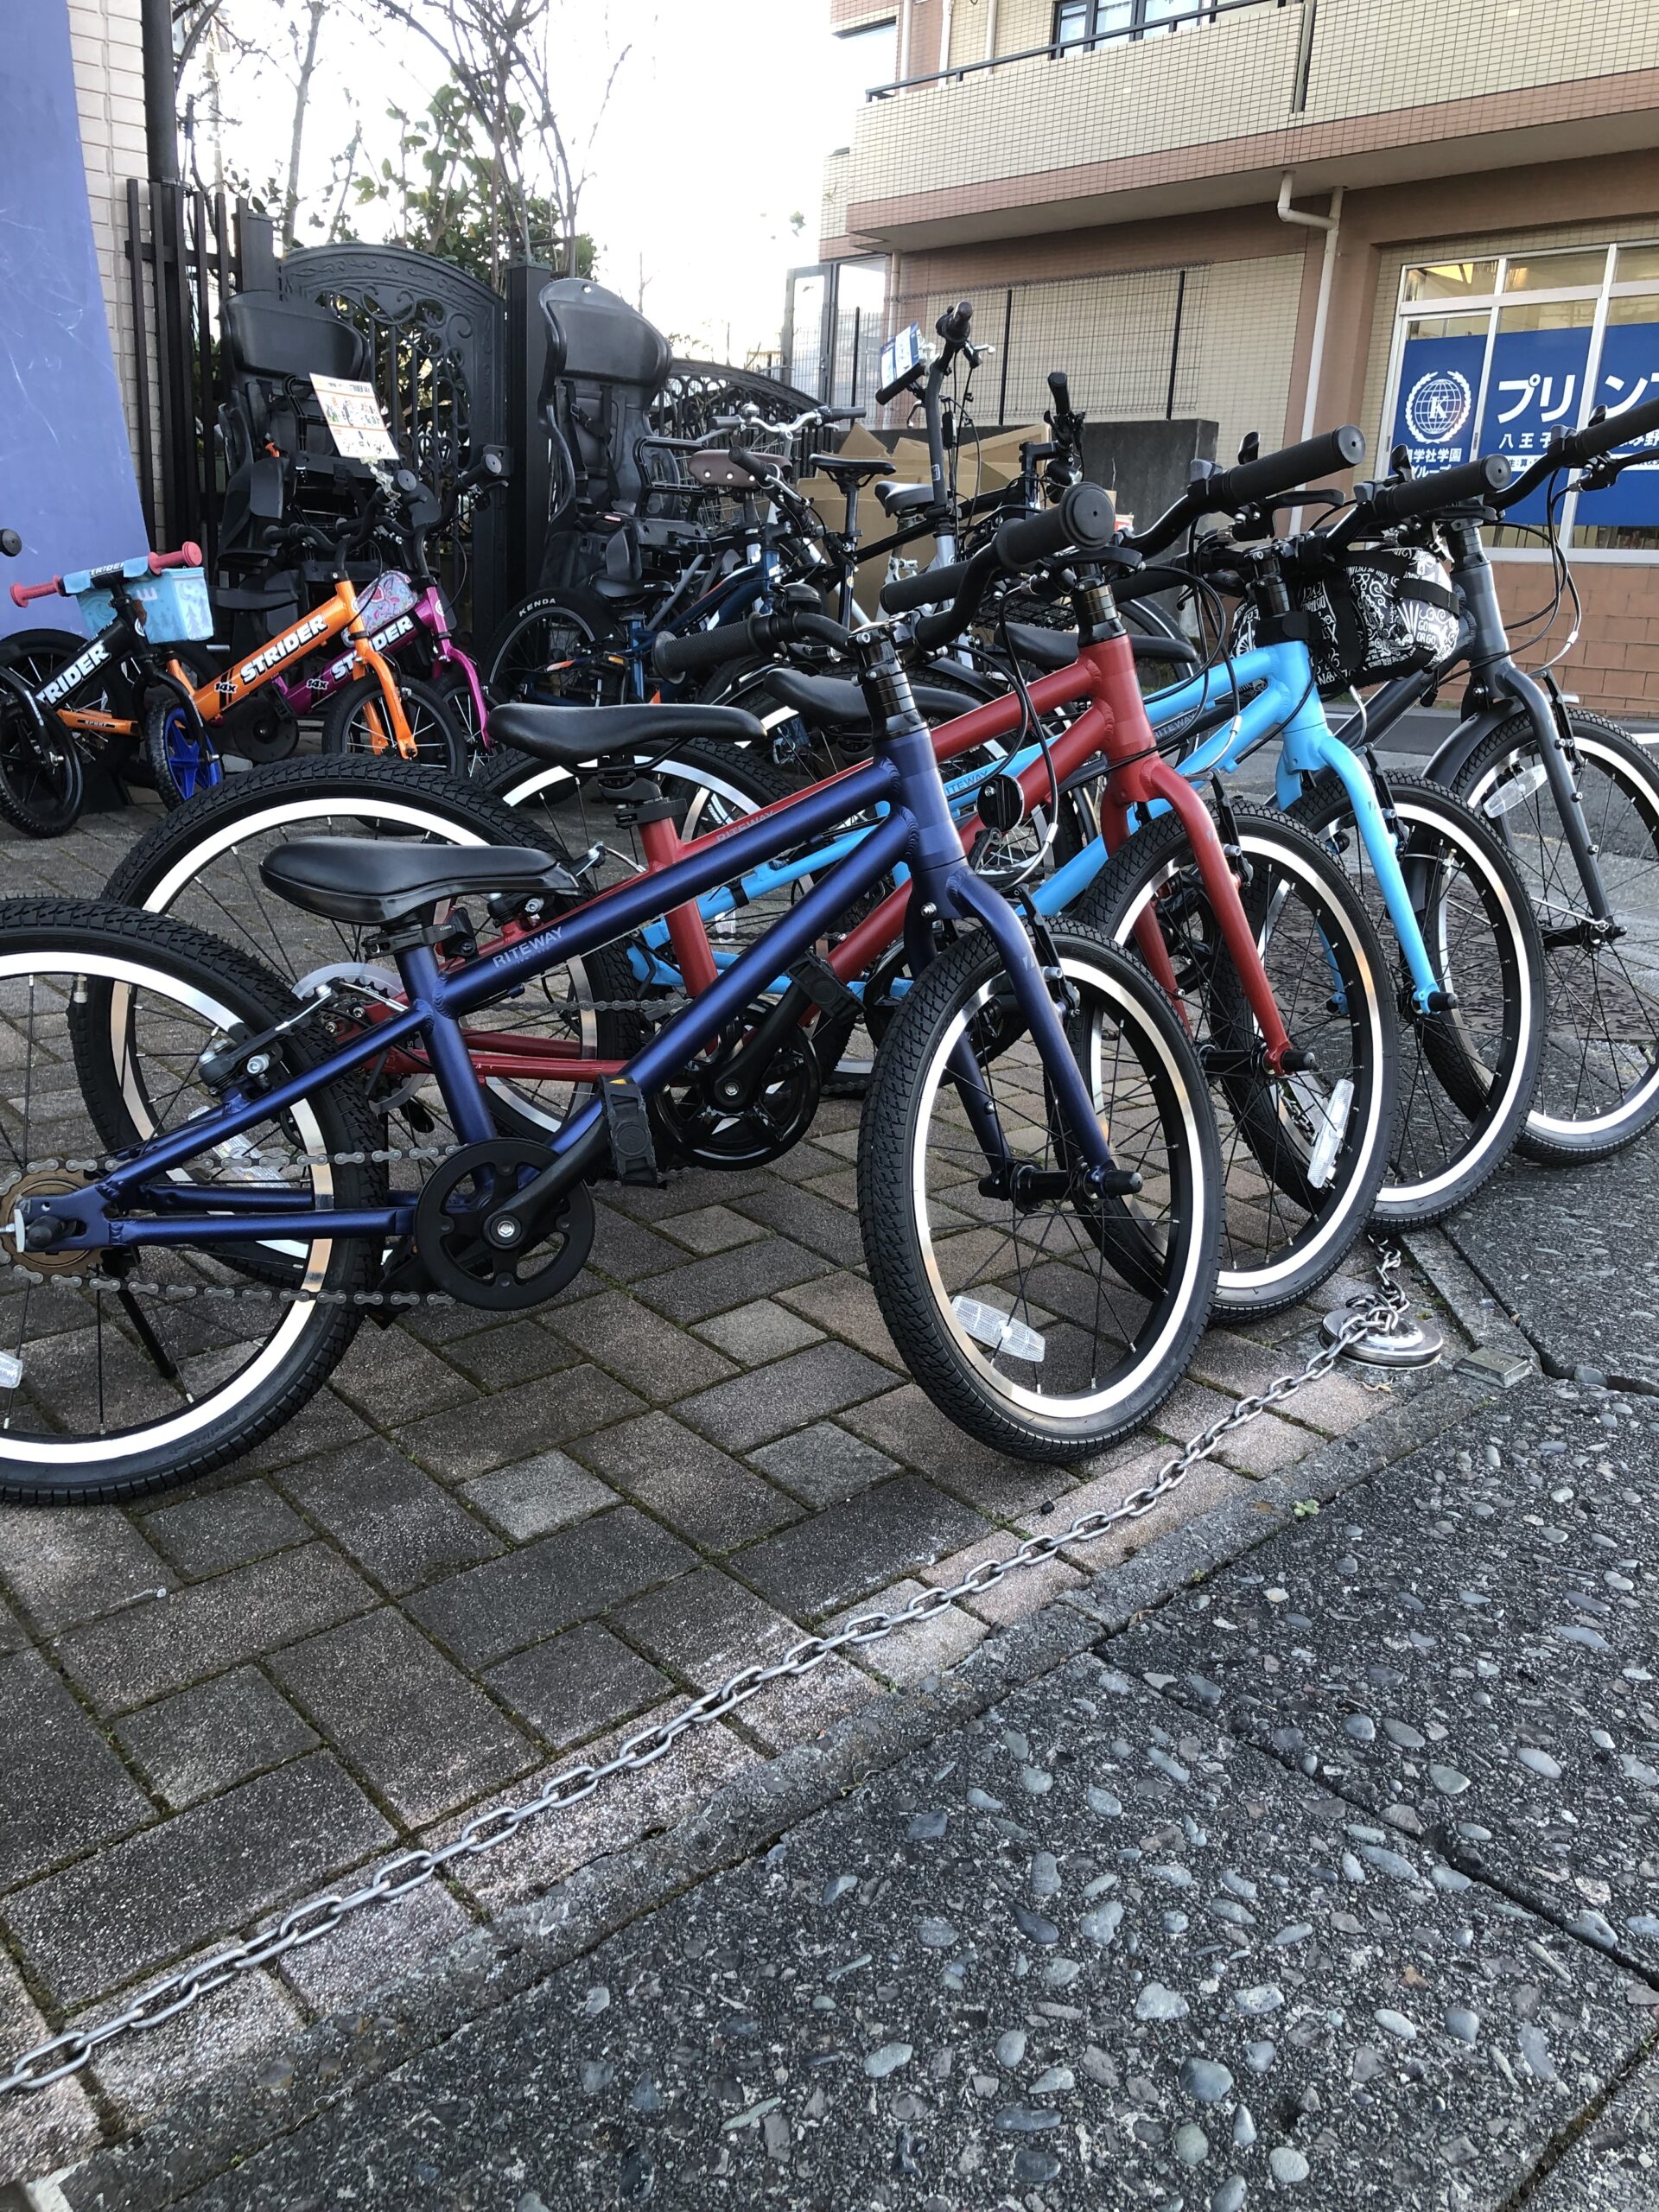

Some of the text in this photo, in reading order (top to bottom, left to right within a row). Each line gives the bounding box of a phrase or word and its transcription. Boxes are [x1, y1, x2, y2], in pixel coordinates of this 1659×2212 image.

[1497, 372, 1659, 423] プリン
[91, 562, 124, 575] TRIDE
[518, 597, 556, 617] KENDA
[240, 614, 328, 683] STRIDER
[332, 615, 414, 680] STIDER
[35, 641, 110, 704] TRIDER
[945, 770, 988, 794] ITEWAY
[493, 926, 563, 968] RITEWAY
